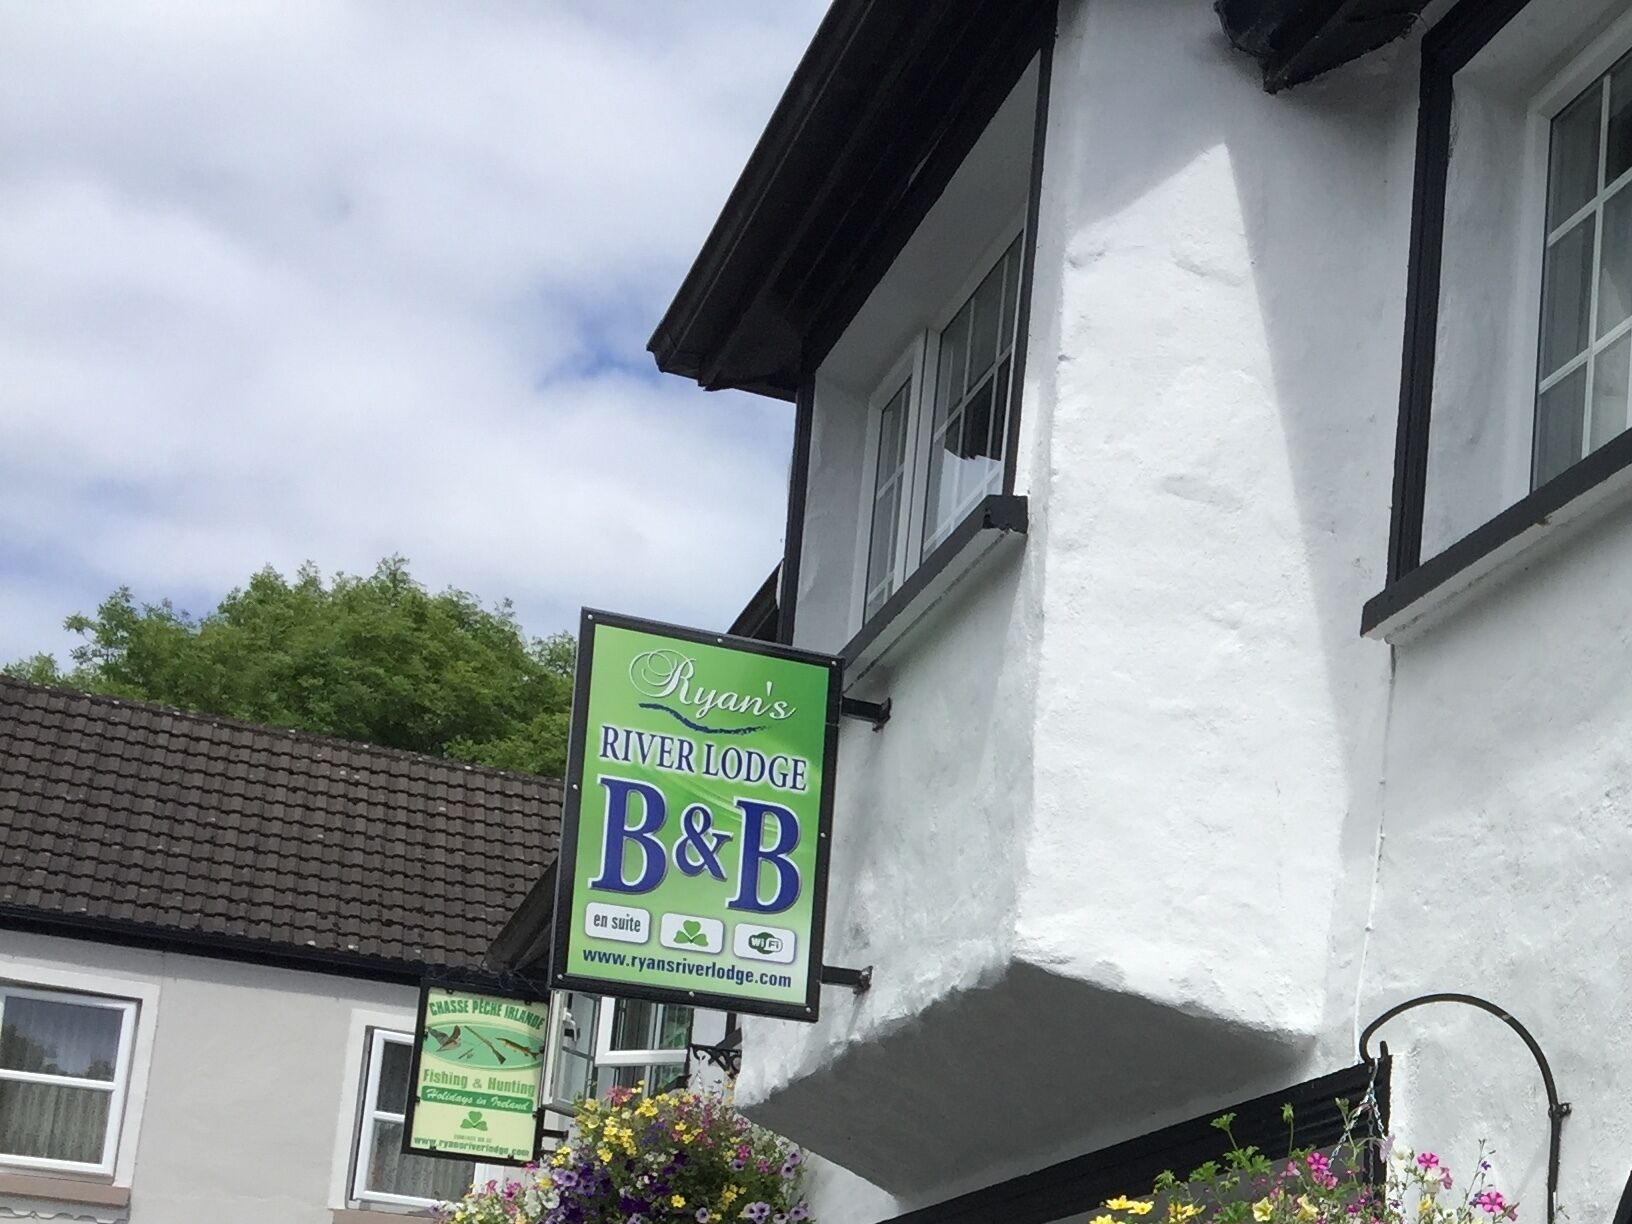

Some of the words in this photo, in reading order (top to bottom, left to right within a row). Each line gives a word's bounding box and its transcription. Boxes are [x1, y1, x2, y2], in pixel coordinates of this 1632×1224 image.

[629, 648, 797, 719] Ryan's
[600, 725, 695, 773] RIVER
[703, 743, 807, 791] LODGE
[588, 773, 801, 914] B&B
[593, 914, 608, 928] en
[611, 913, 641, 933] suite
[583, 949, 792, 988] www.ryansriverlodge.com
[429, 999, 469, 1016] CHASSE
[504, 1005, 545, 1030] IRLANDE
[423, 1069, 468, 1089] Fishing
[472, 1078, 482, 1088] &
[487, 1077, 536, 1097] Hunting
[426, 1088, 473, 1105] Holidays
[476, 1095, 486, 1105] in
[490, 1095, 530, 1110] Ireland
